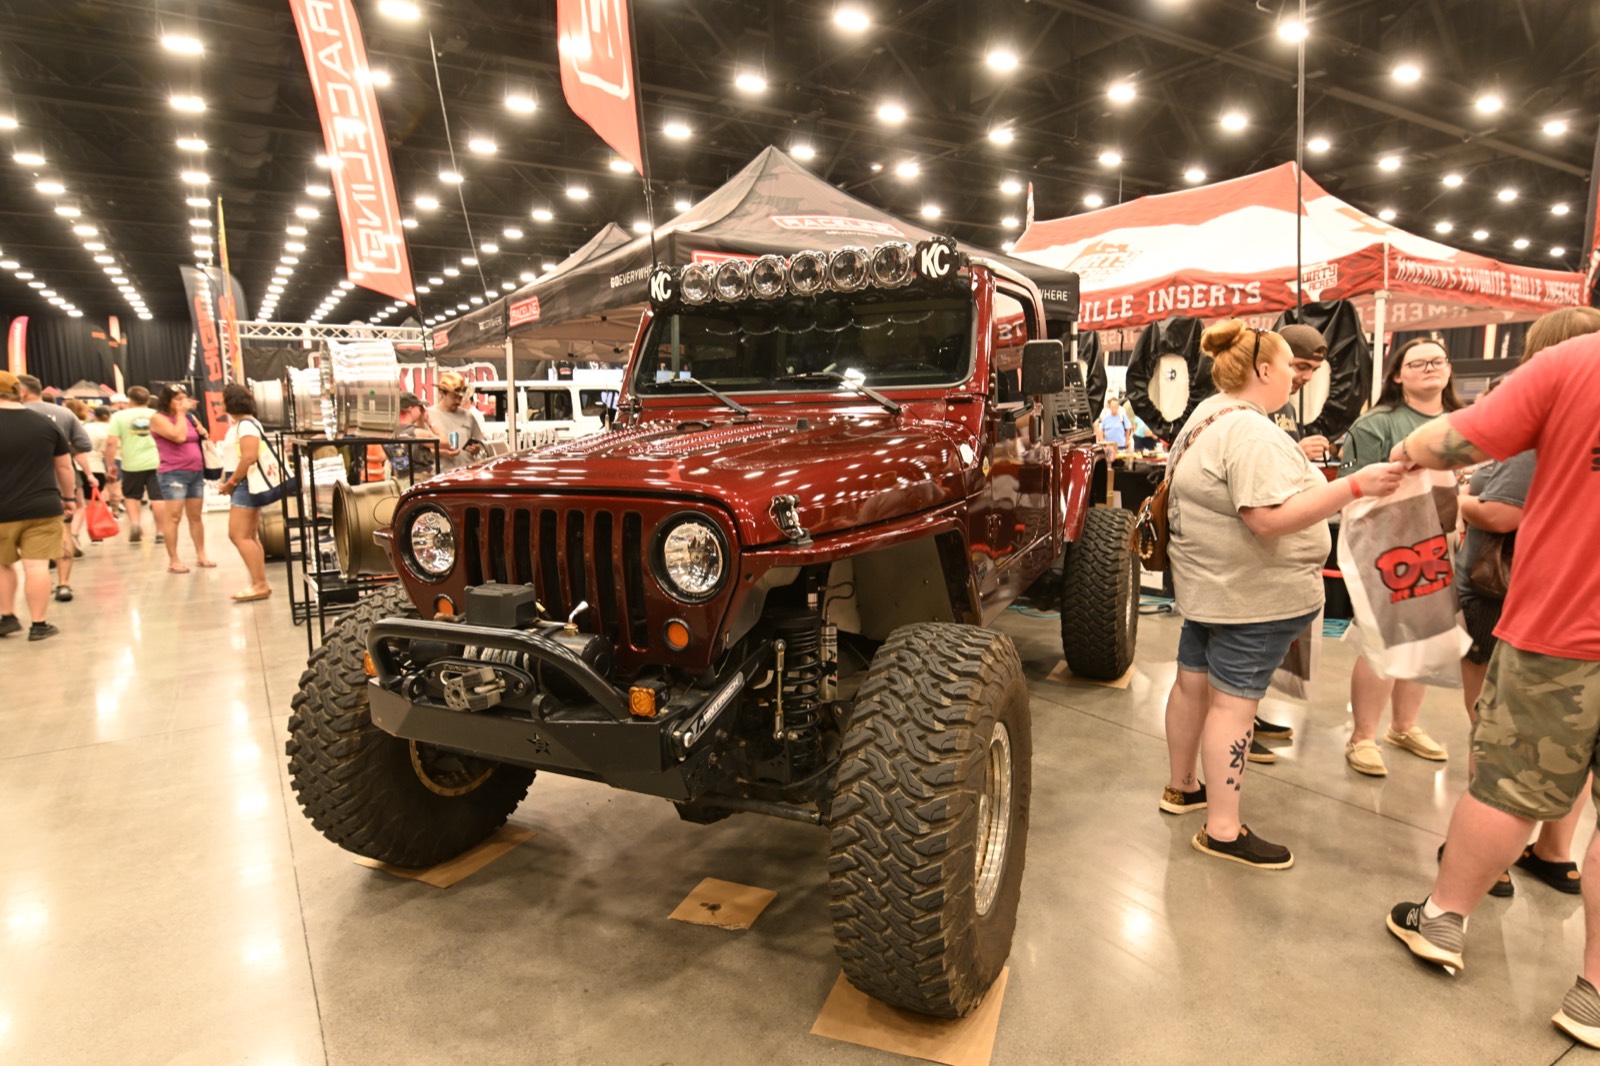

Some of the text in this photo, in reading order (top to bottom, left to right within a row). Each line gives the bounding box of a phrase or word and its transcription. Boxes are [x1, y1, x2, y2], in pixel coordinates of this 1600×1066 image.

[921, 242, 950, 278] KC
[650, 270, 672, 302] KC
[1147, 281, 1262, 314] INSERTS
[1458, 266, 1507, 297] FAVORITE
[1509, 274, 1543, 302] GRILLE
